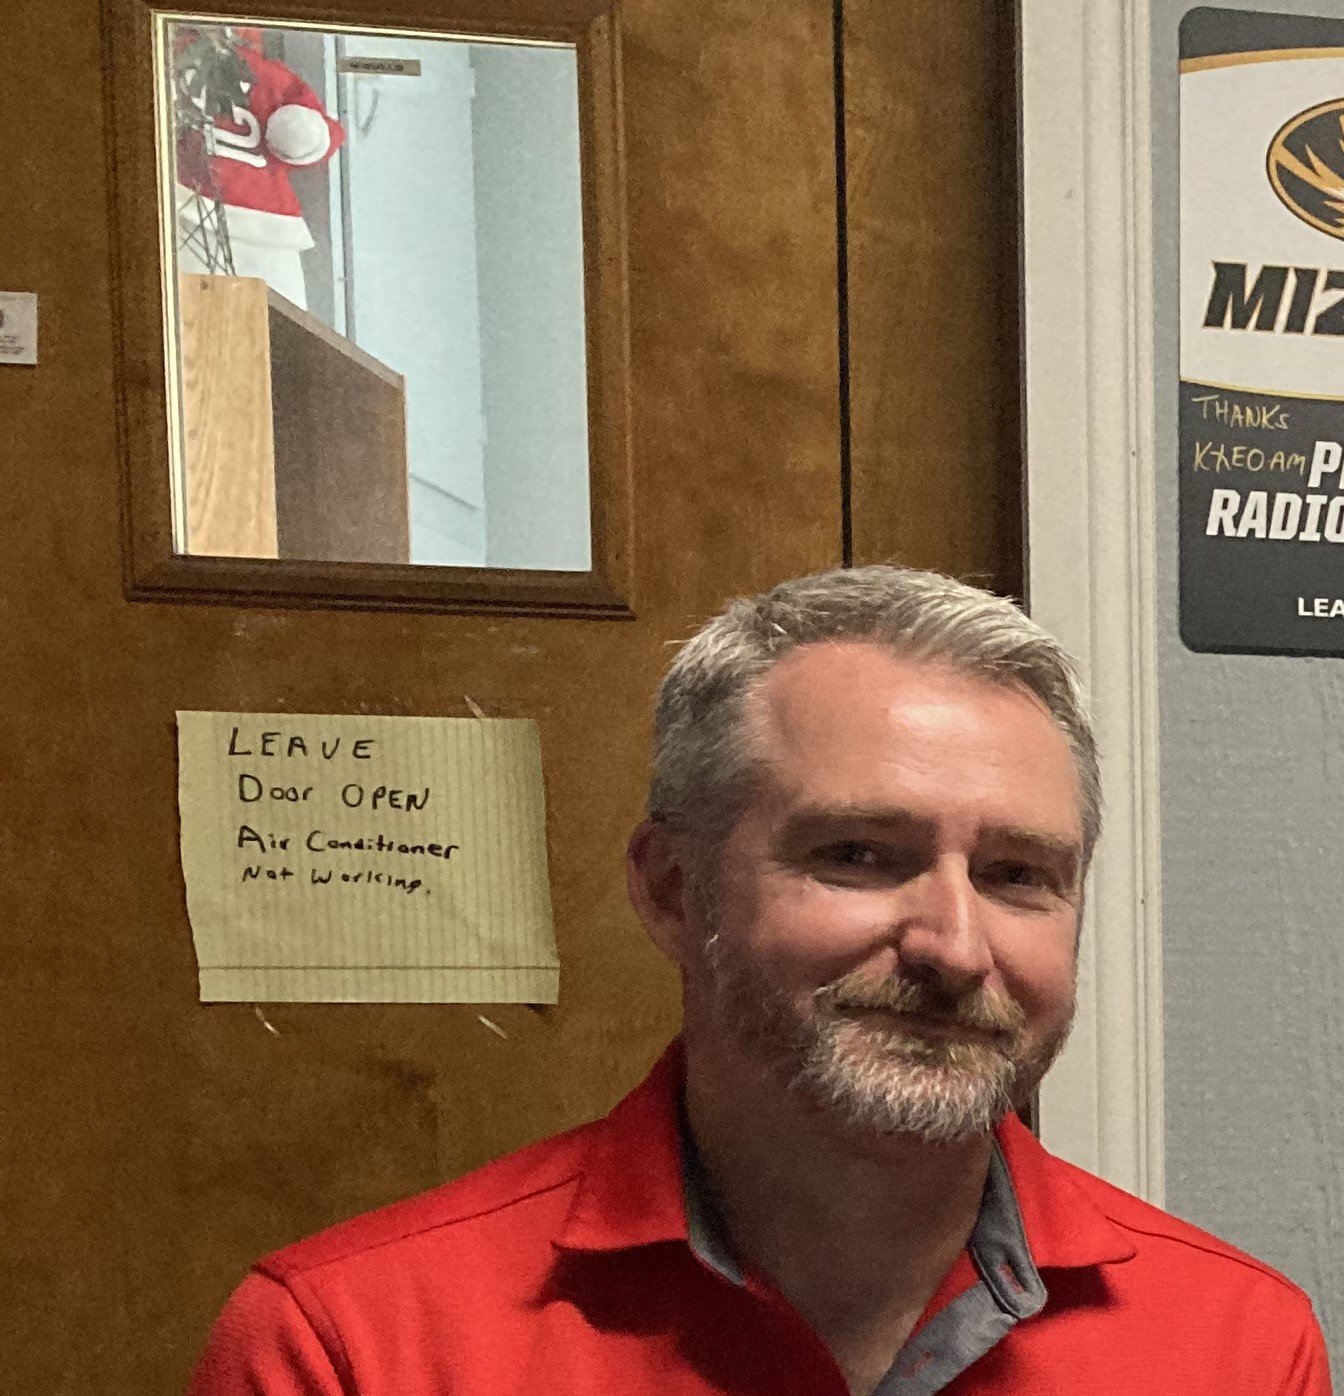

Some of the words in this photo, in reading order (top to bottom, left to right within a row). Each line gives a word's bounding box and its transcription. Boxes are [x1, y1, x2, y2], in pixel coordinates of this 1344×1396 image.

[1191, 394, 1291, 430] THANKS
[227, 727, 375, 760] LEAVE
[238, 773, 315, 803] Door
[341, 782, 430, 812] OPEN
[237, 825, 291, 853] Air
[242, 865, 294, 883] Not
